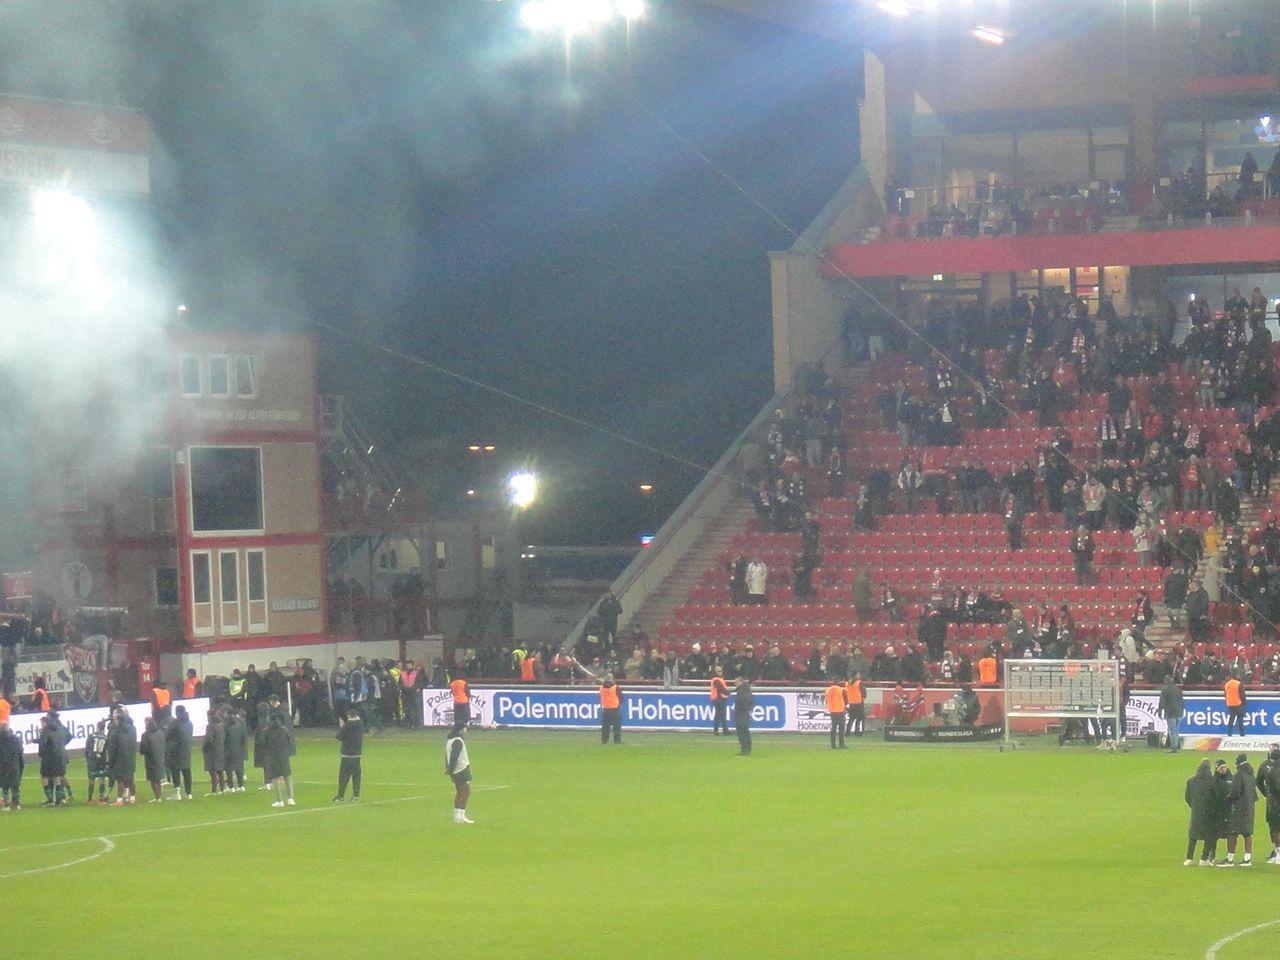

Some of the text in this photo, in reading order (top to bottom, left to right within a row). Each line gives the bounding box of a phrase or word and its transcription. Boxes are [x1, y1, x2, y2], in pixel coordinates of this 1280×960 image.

[499, 697, 780, 722] Polenmar Hohenwen
[1253, 740, 1272, 749] Lieb
